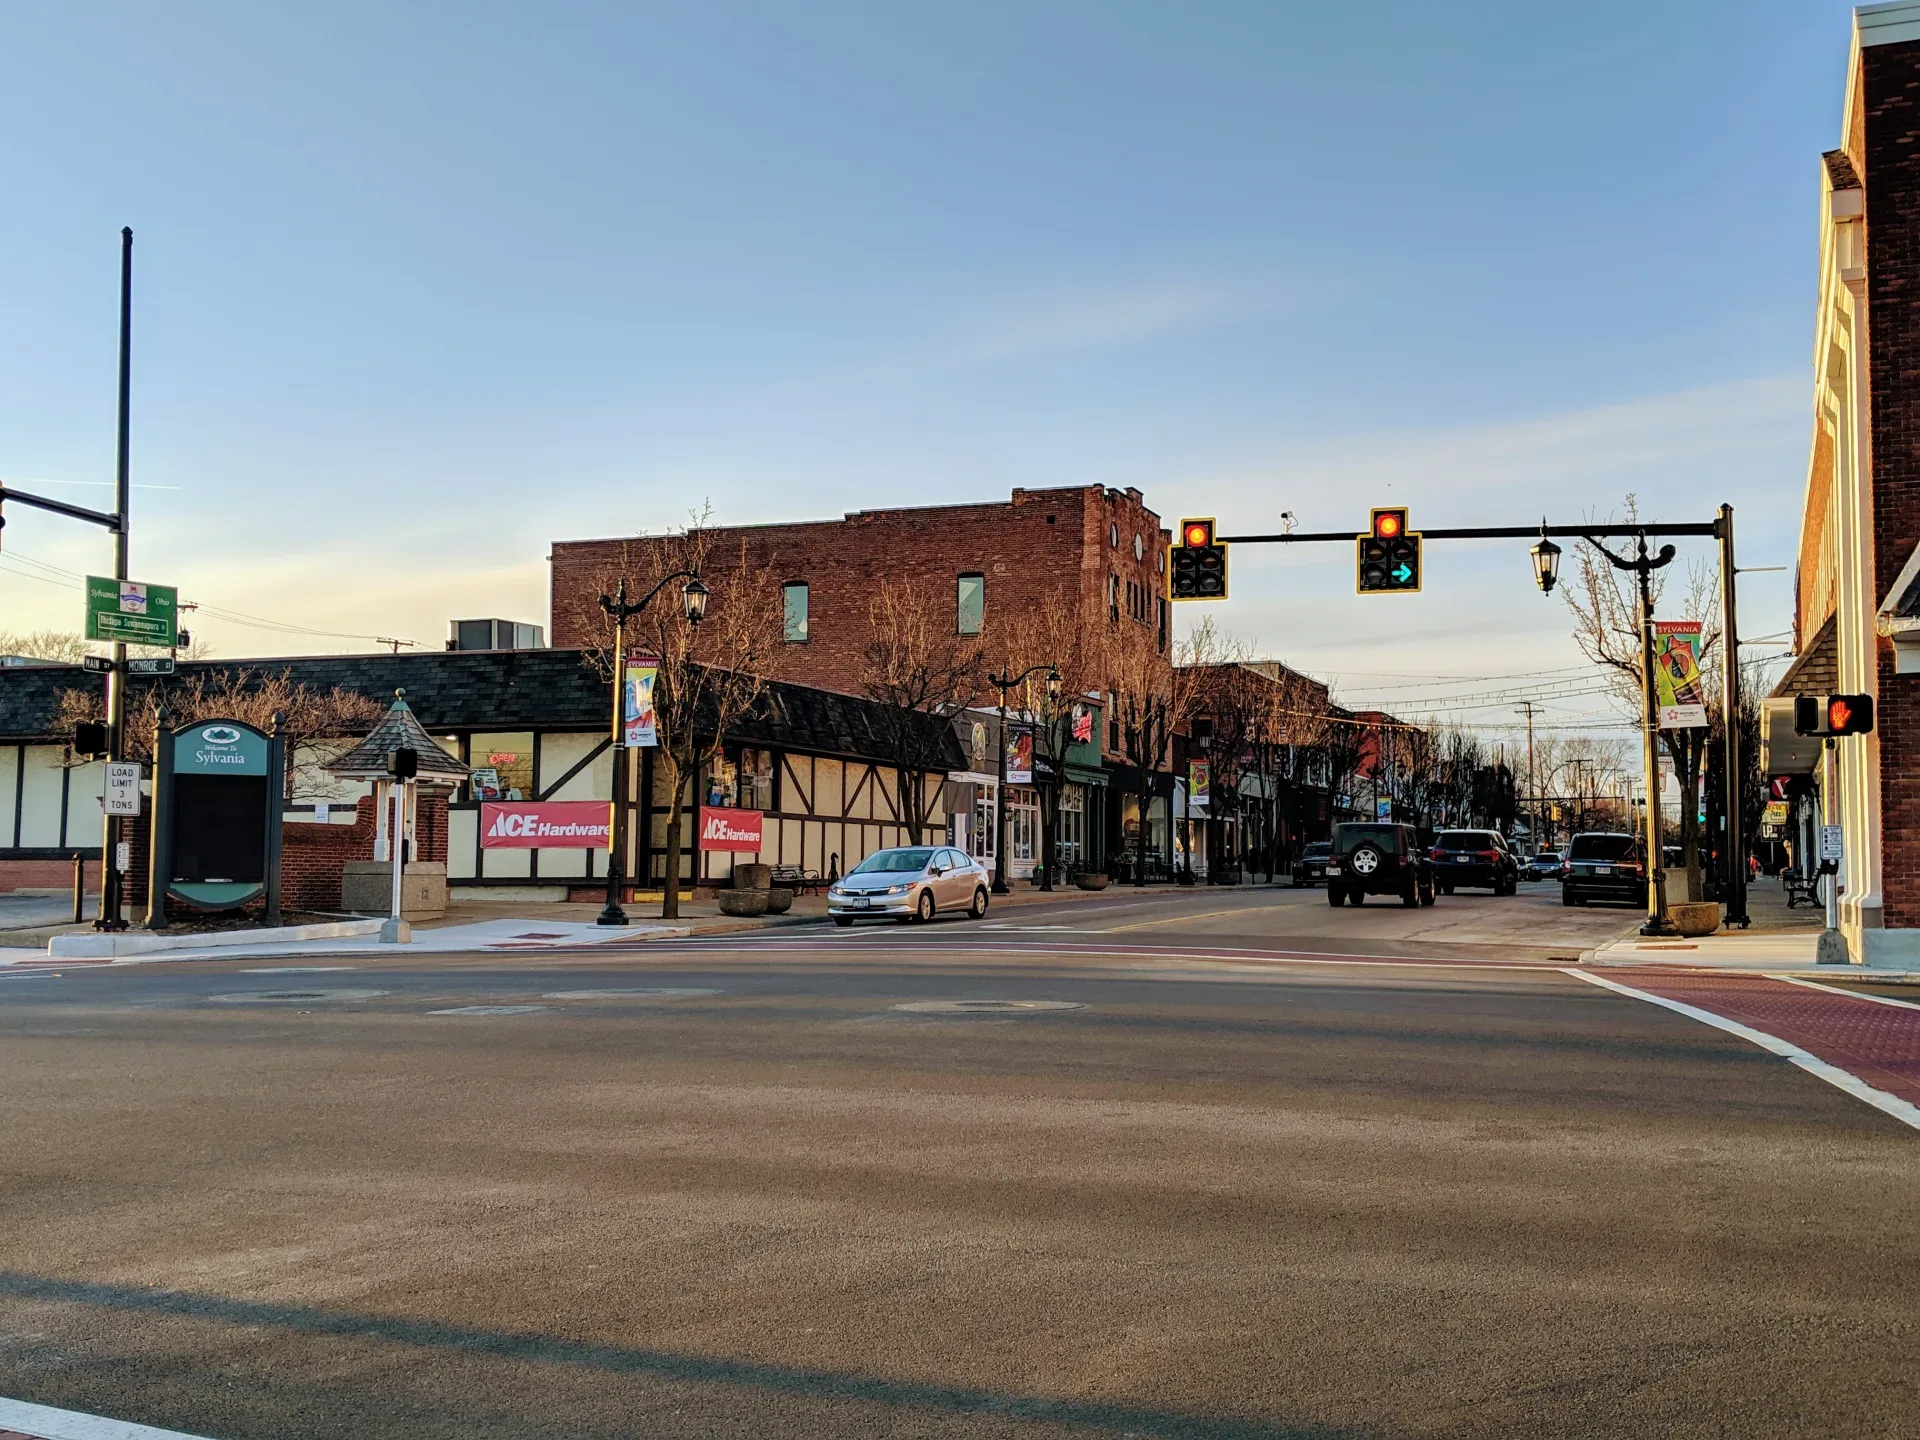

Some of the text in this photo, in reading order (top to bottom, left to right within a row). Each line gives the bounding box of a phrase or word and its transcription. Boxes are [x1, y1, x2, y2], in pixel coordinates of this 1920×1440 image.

[91, 589, 118, 599] Sylvania
[155, 598, 170, 606] Ohio
[1658, 626, 1699, 634] SYLVANIA
[86, 659, 100, 669] MAIN
[128, 660, 158, 672] MONROE
[195, 751, 245, 766] Sylvania
[489, 752, 516, 765] OPEN
[112, 768, 133, 777] LOAD
[112, 780, 132, 788] LIMIT
[119, 790, 125, 798] 3
[111, 801, 132, 809] TONS
[487, 811, 610, 837] ACE Hardware
[703, 815, 760, 842] ACE Hardware
